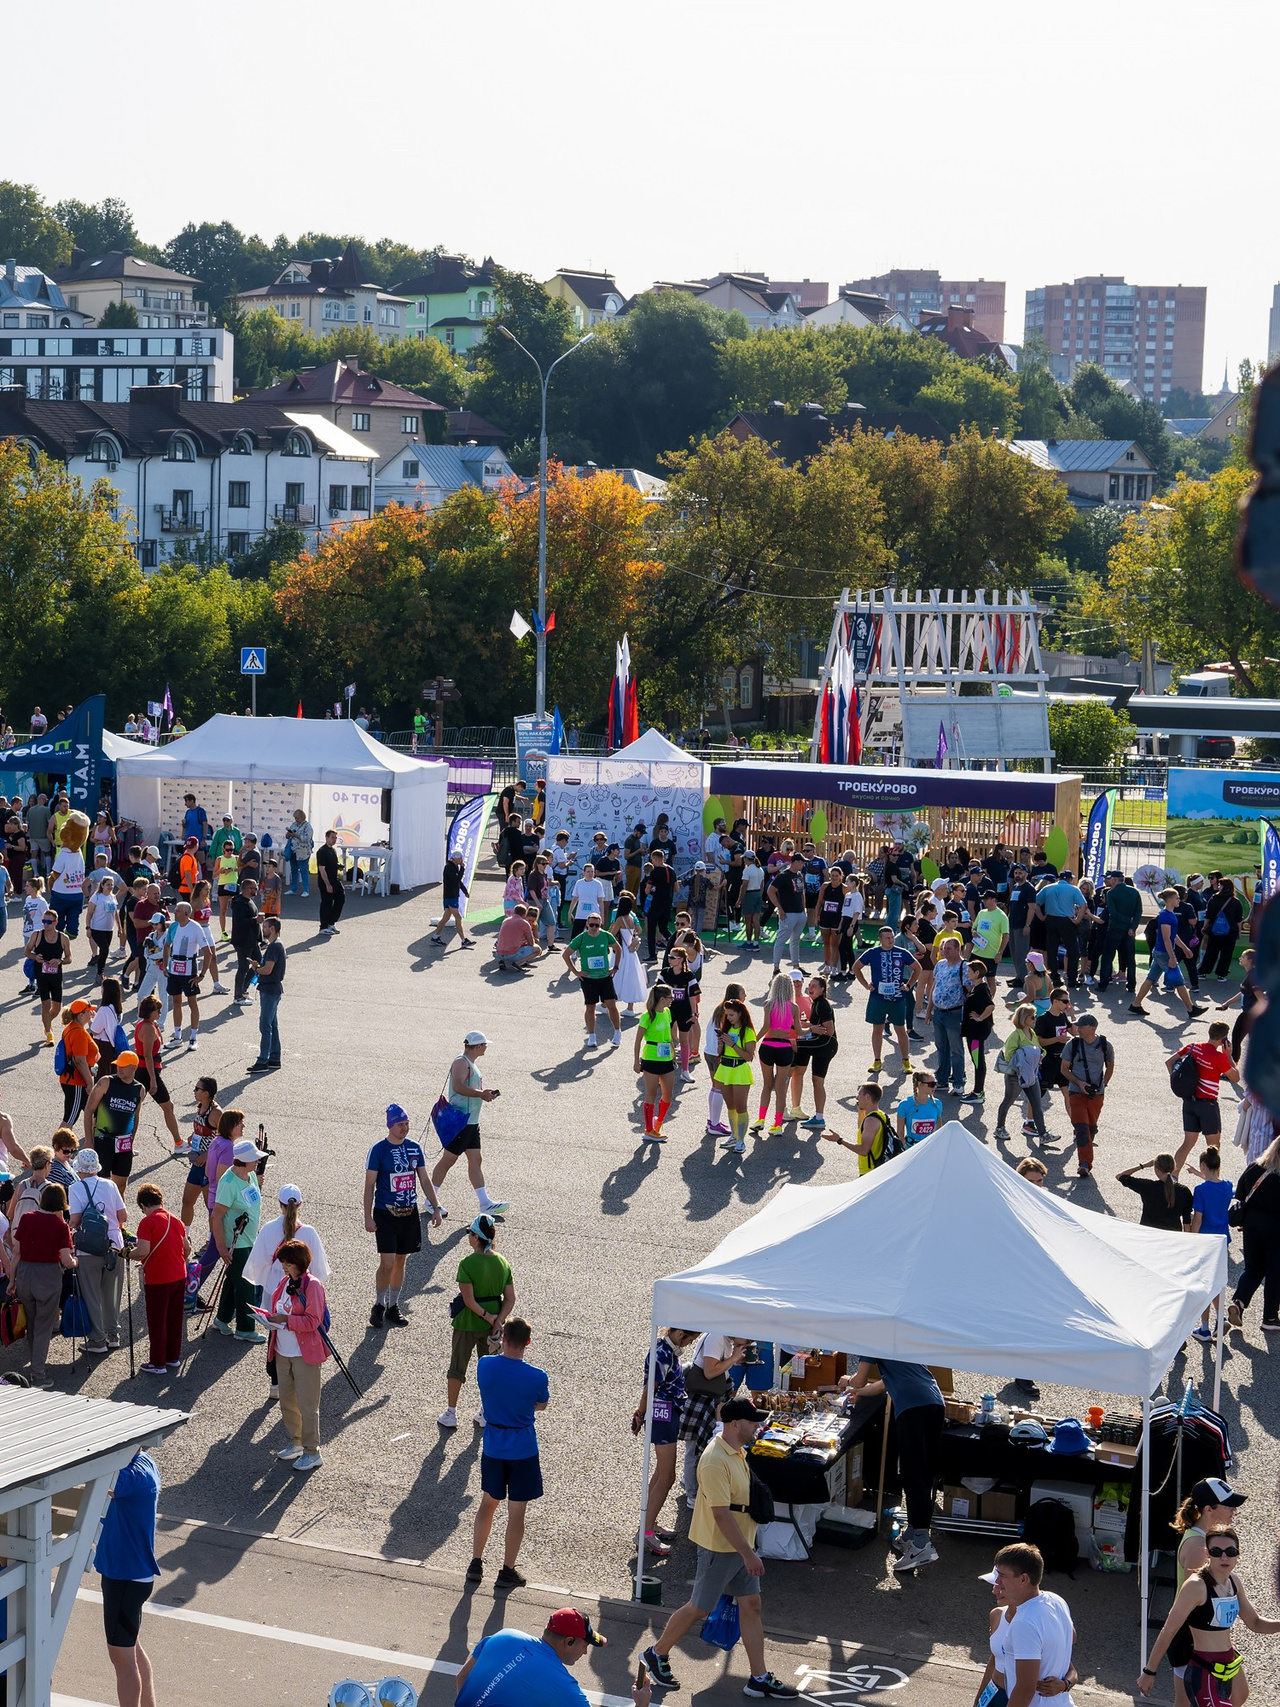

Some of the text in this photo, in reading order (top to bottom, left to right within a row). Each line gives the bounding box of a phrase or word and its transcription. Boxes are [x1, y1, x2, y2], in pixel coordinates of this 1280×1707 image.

[73, 744, 90, 800] J.A.M
[837, 781, 917, 795] ТРОЕКУРОВО
[1087, 822, 1102, 878] ЕКУРОВО
[919, 1126, 933, 1134] 2422
[399, 1181, 413, 1189] 4613
[480, 1652, 526, 1701] 10 ЛЕТ БЕЖИМ
